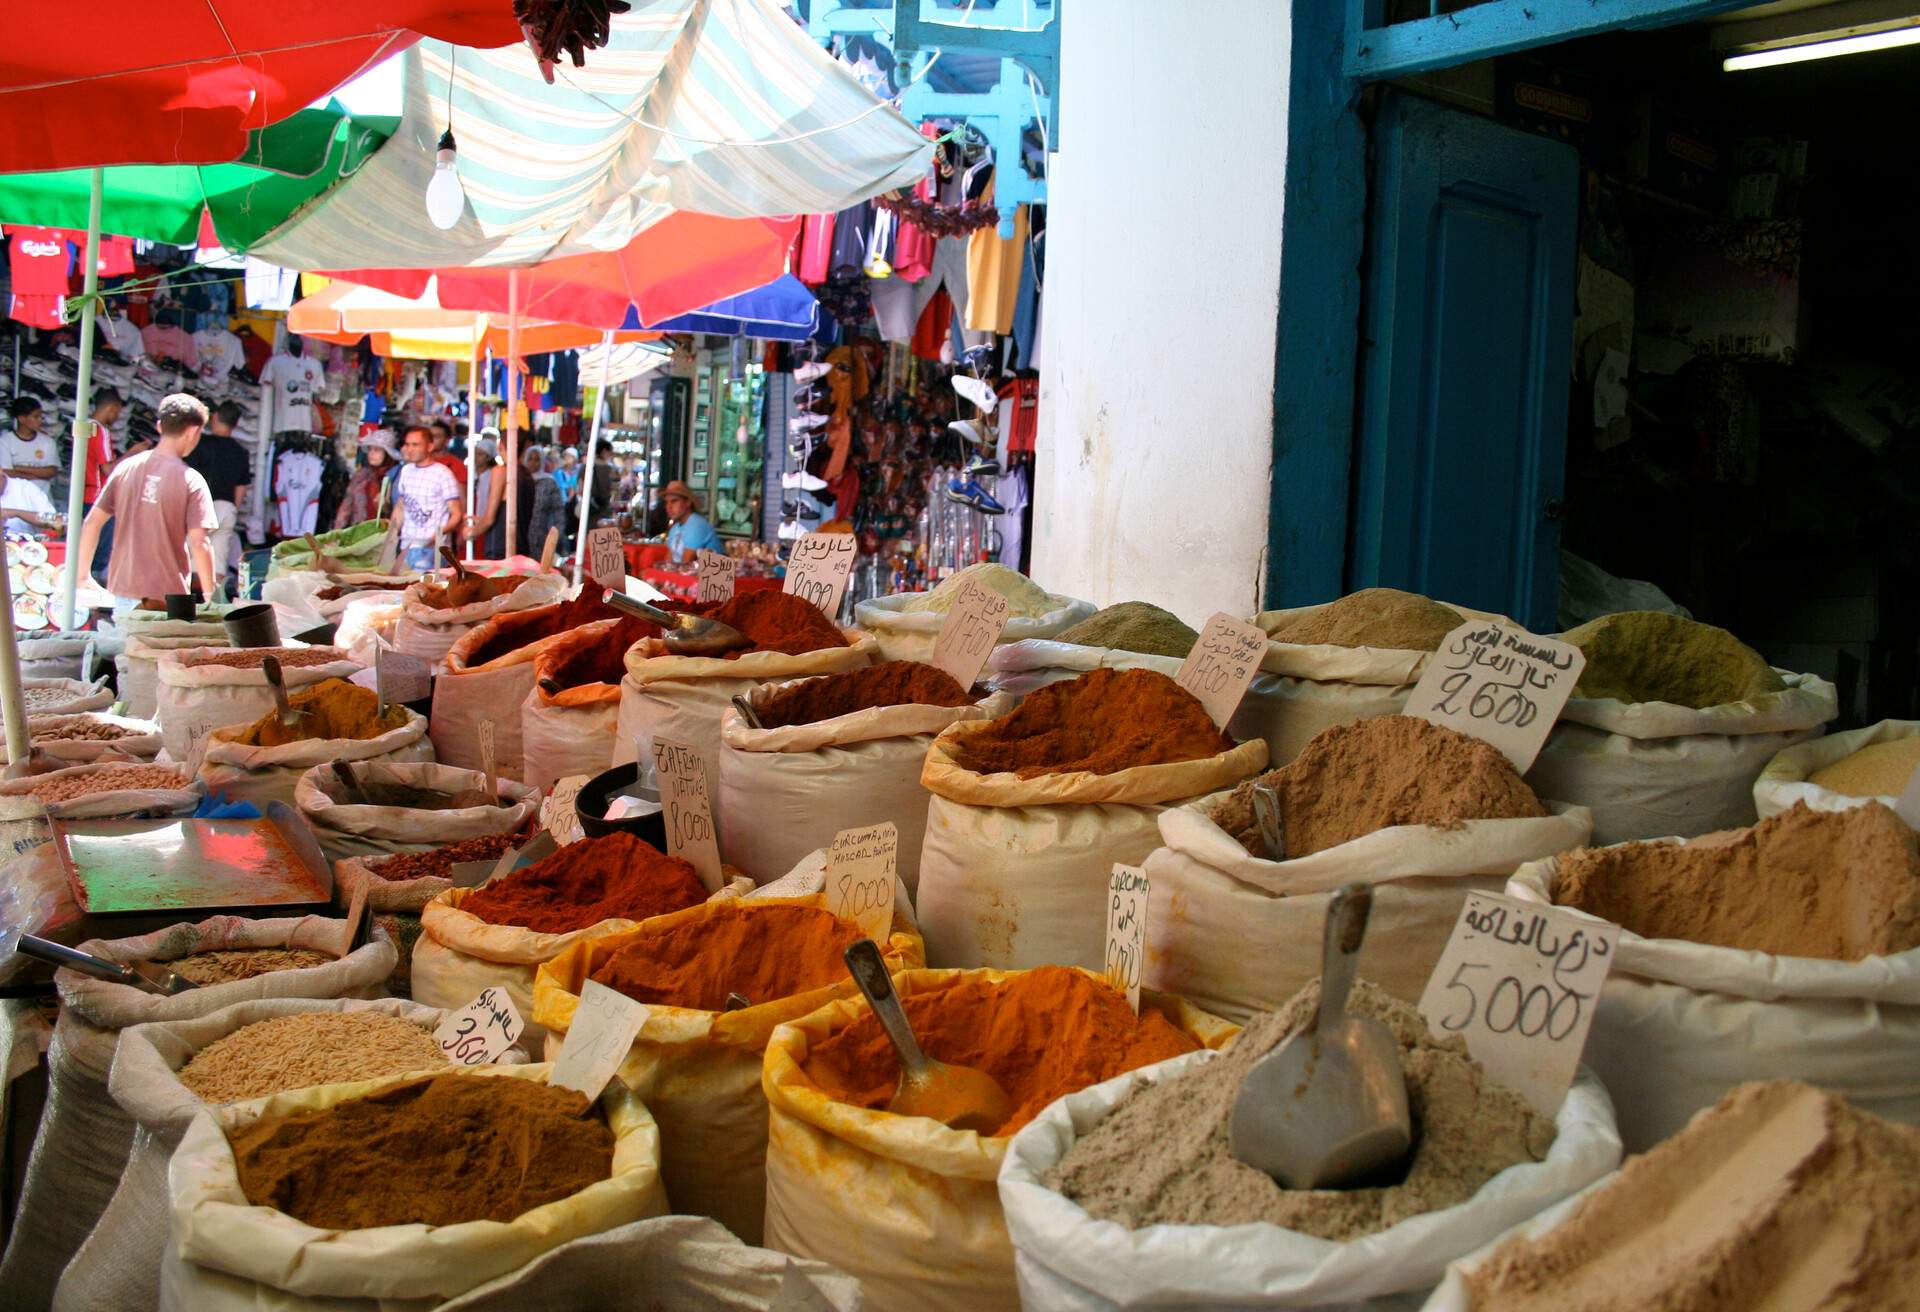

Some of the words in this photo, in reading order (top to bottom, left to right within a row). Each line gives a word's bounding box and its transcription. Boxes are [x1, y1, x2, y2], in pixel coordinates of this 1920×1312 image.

[1431, 672, 1538, 728] 2600
[670, 801, 711, 850] 8000
[838, 874, 890, 917] 8000
[1440, 961, 1582, 1042] 5000
